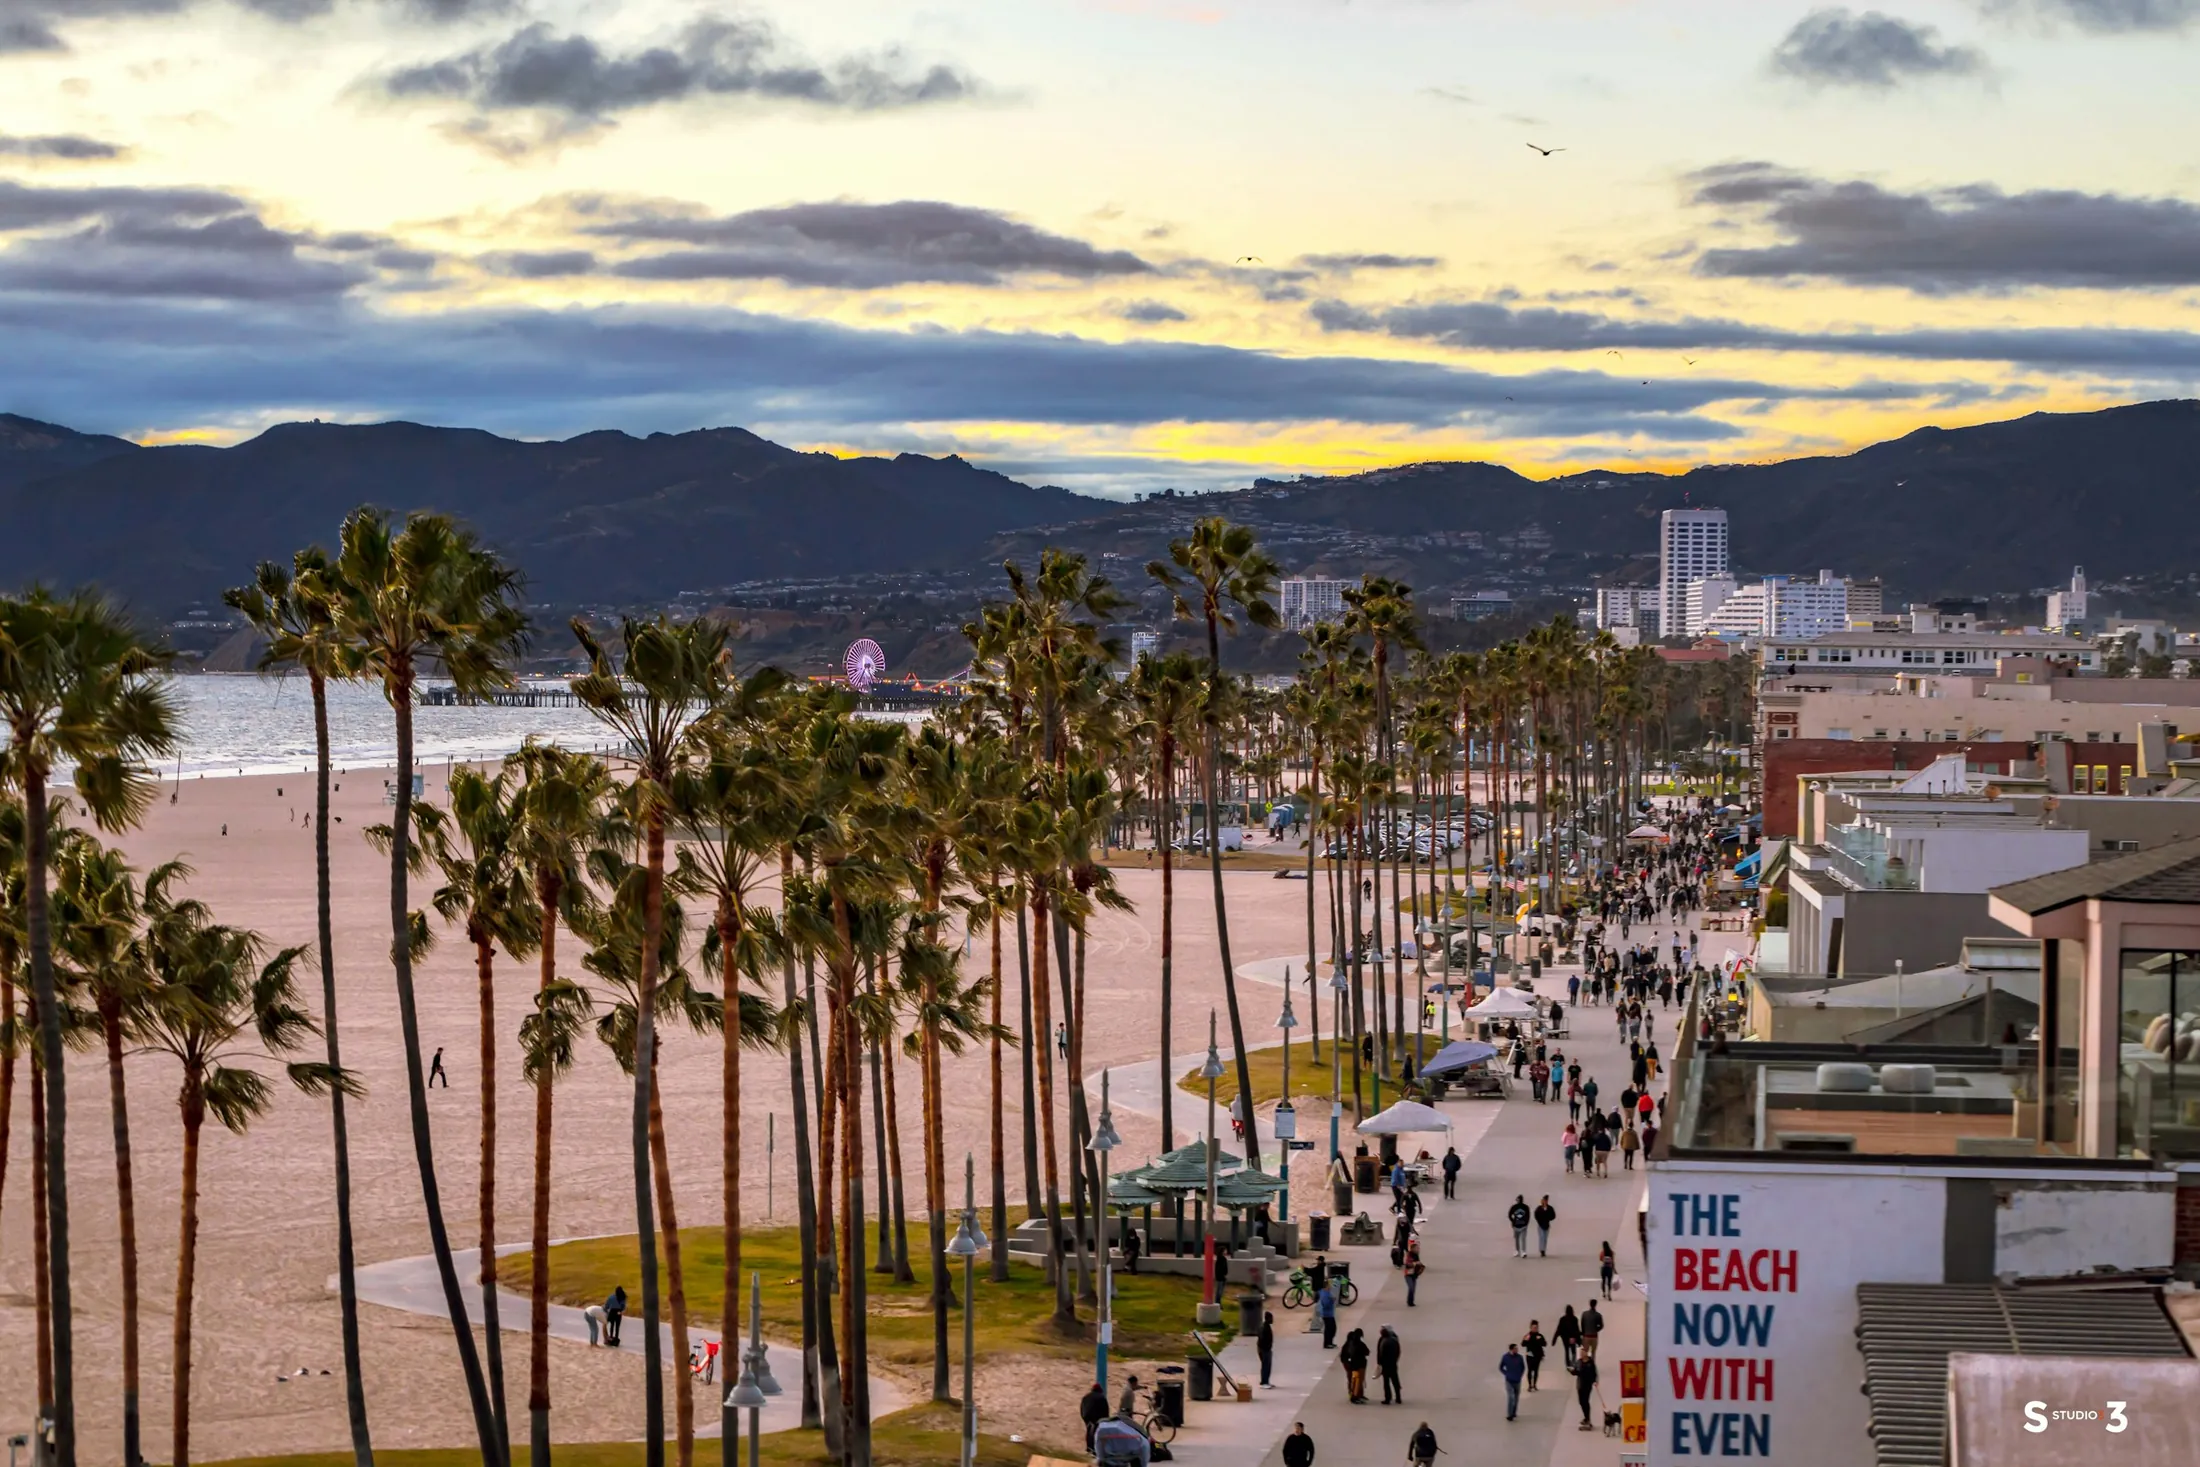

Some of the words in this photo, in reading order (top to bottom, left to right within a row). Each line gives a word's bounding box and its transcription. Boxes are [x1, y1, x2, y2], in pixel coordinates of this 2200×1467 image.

[1669, 1193, 1741, 1237] THE
[1674, 1248, 1798, 1292] BEACH
[1674, 1303, 1775, 1347] NOW
[1668, 1357, 1774, 1402] WITH
[1672, 1412, 1770, 1457] EVEN
